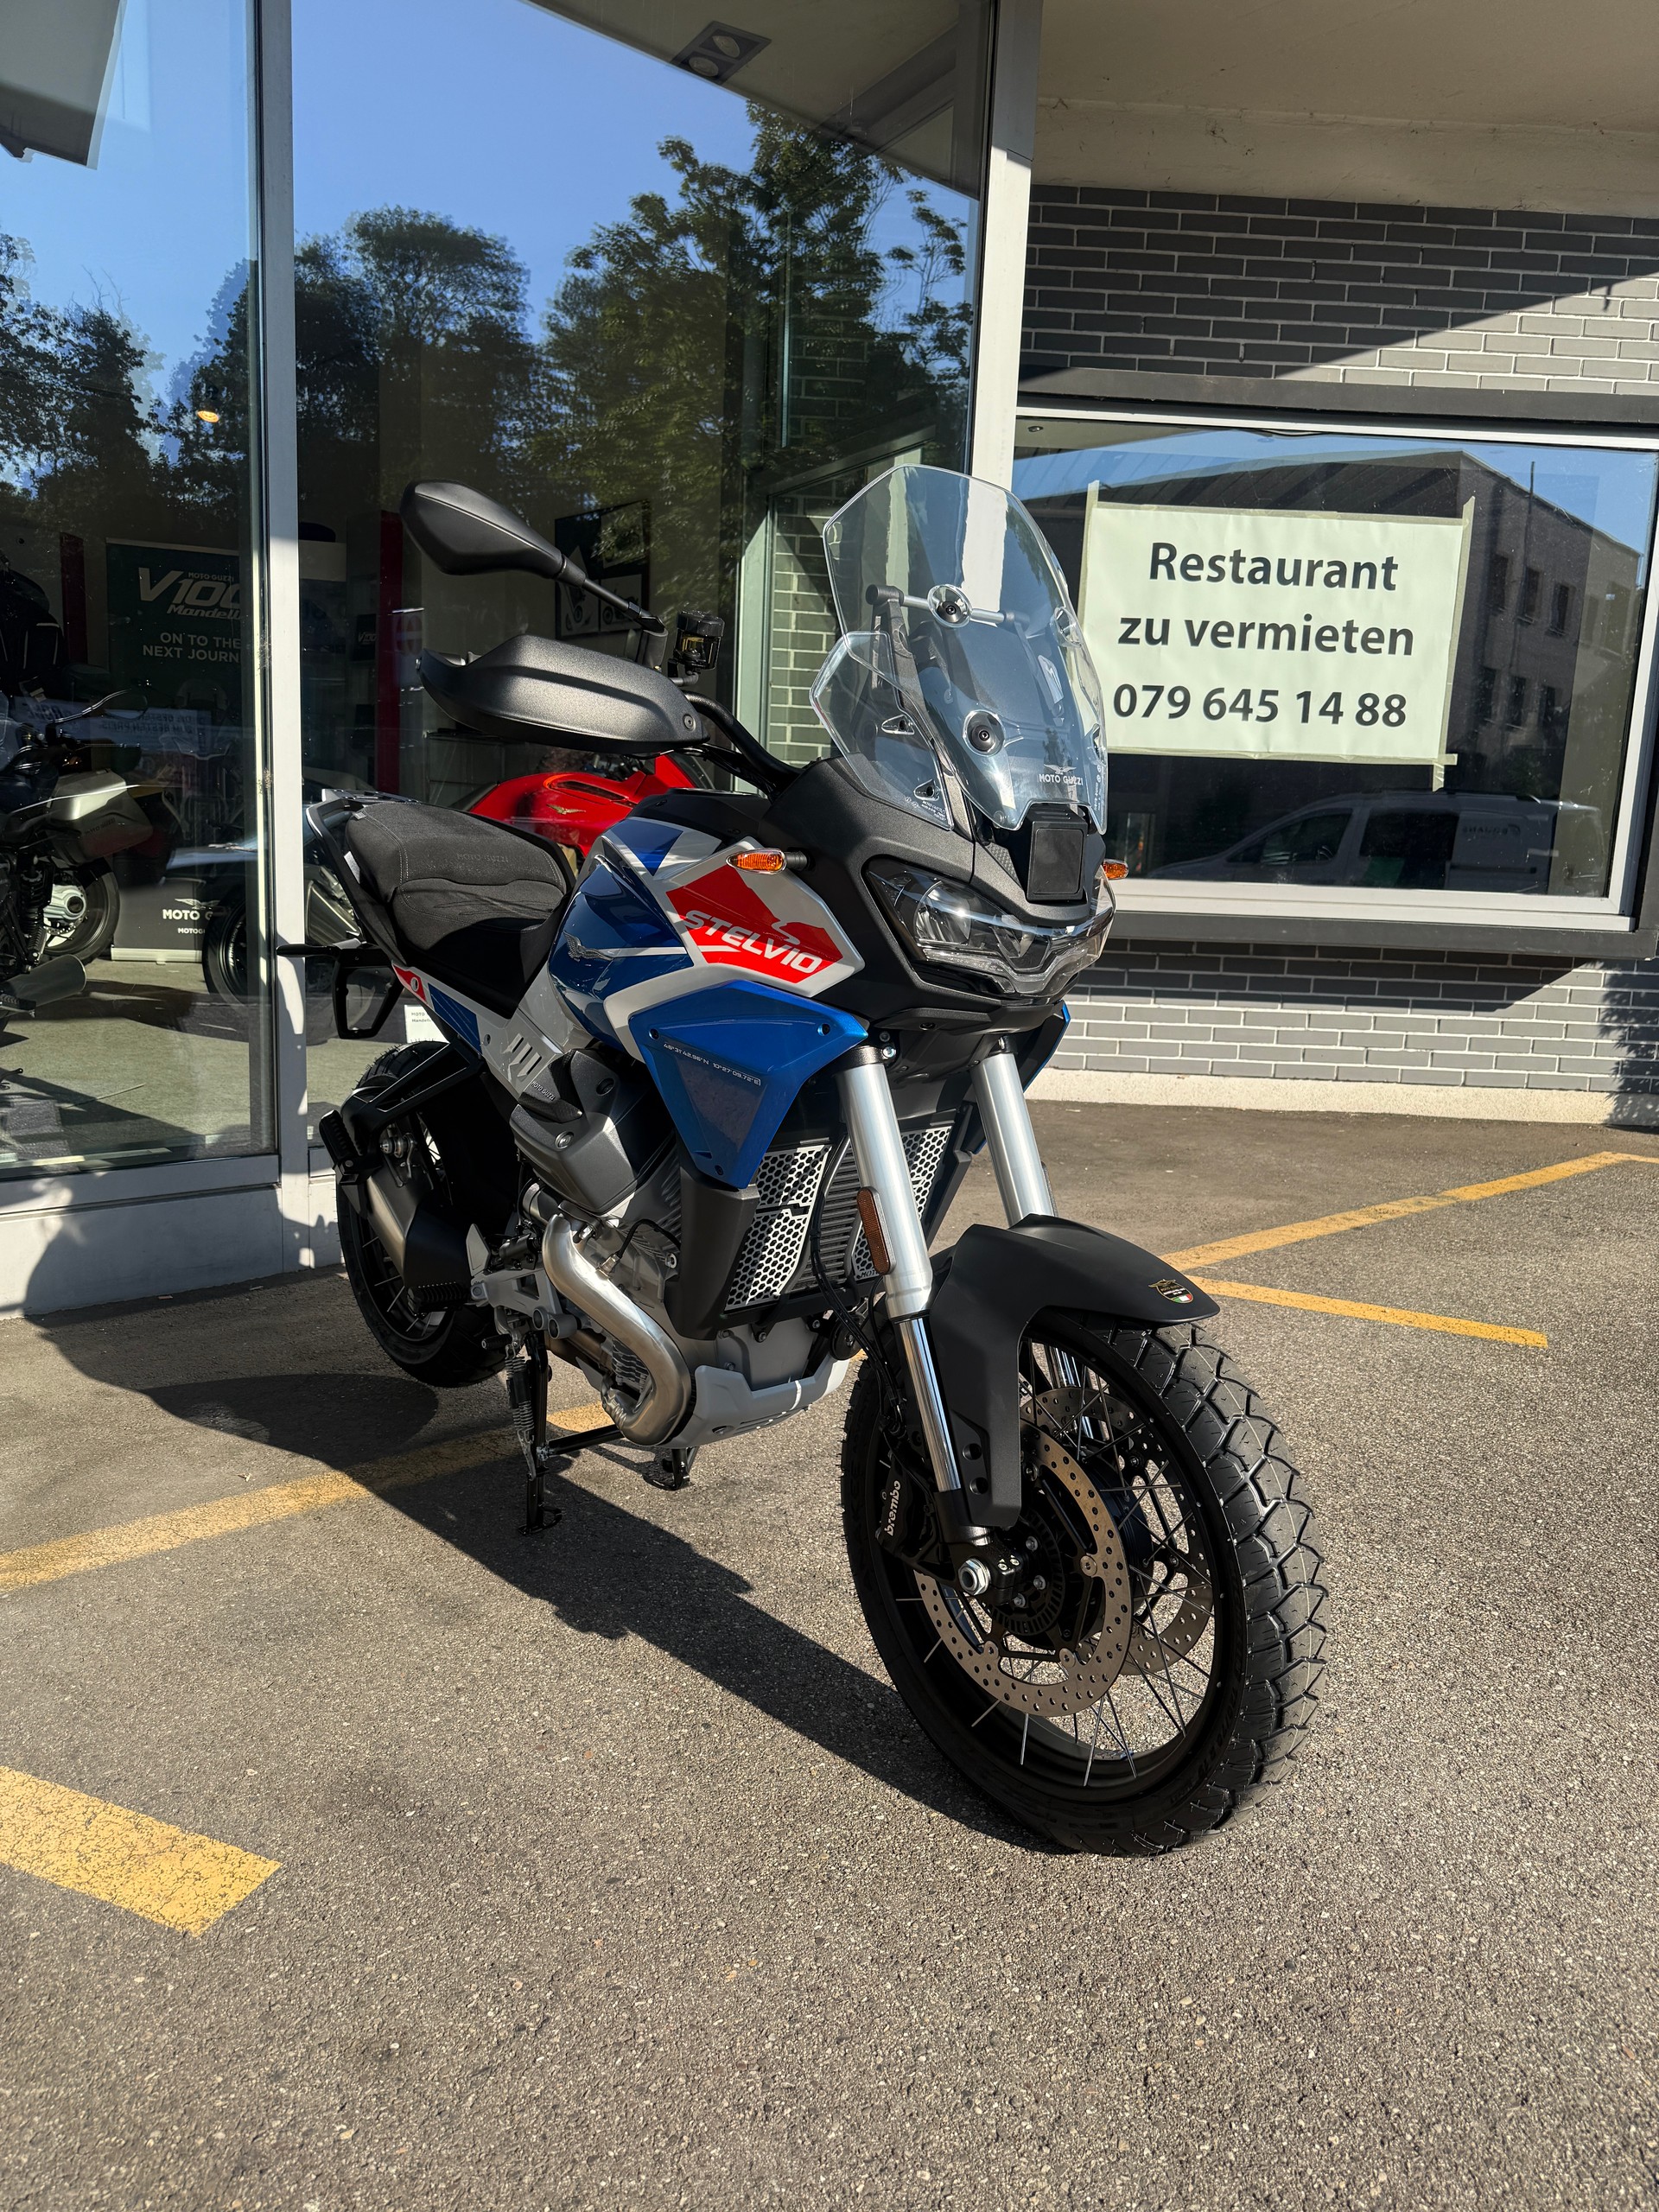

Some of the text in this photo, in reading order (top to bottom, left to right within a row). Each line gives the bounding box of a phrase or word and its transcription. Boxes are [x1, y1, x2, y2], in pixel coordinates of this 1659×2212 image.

[1149, 542, 1399, 591] Restaurant
[160, 632, 241, 649] ON TO THE
[1118, 613, 1414, 656] zu vermieten
[143, 645, 183, 658] NEXT
[1113, 683, 1407, 728] 079 645 14 88
[1039, 773, 1084, 785] MOTO GUZZI
[162, 909, 200, 920] MOTO
[679, 910, 823, 974] STELVIO
[531, 1080, 555, 1101] MOTO GUZZI
[884, 1479, 901, 1536] brembo
